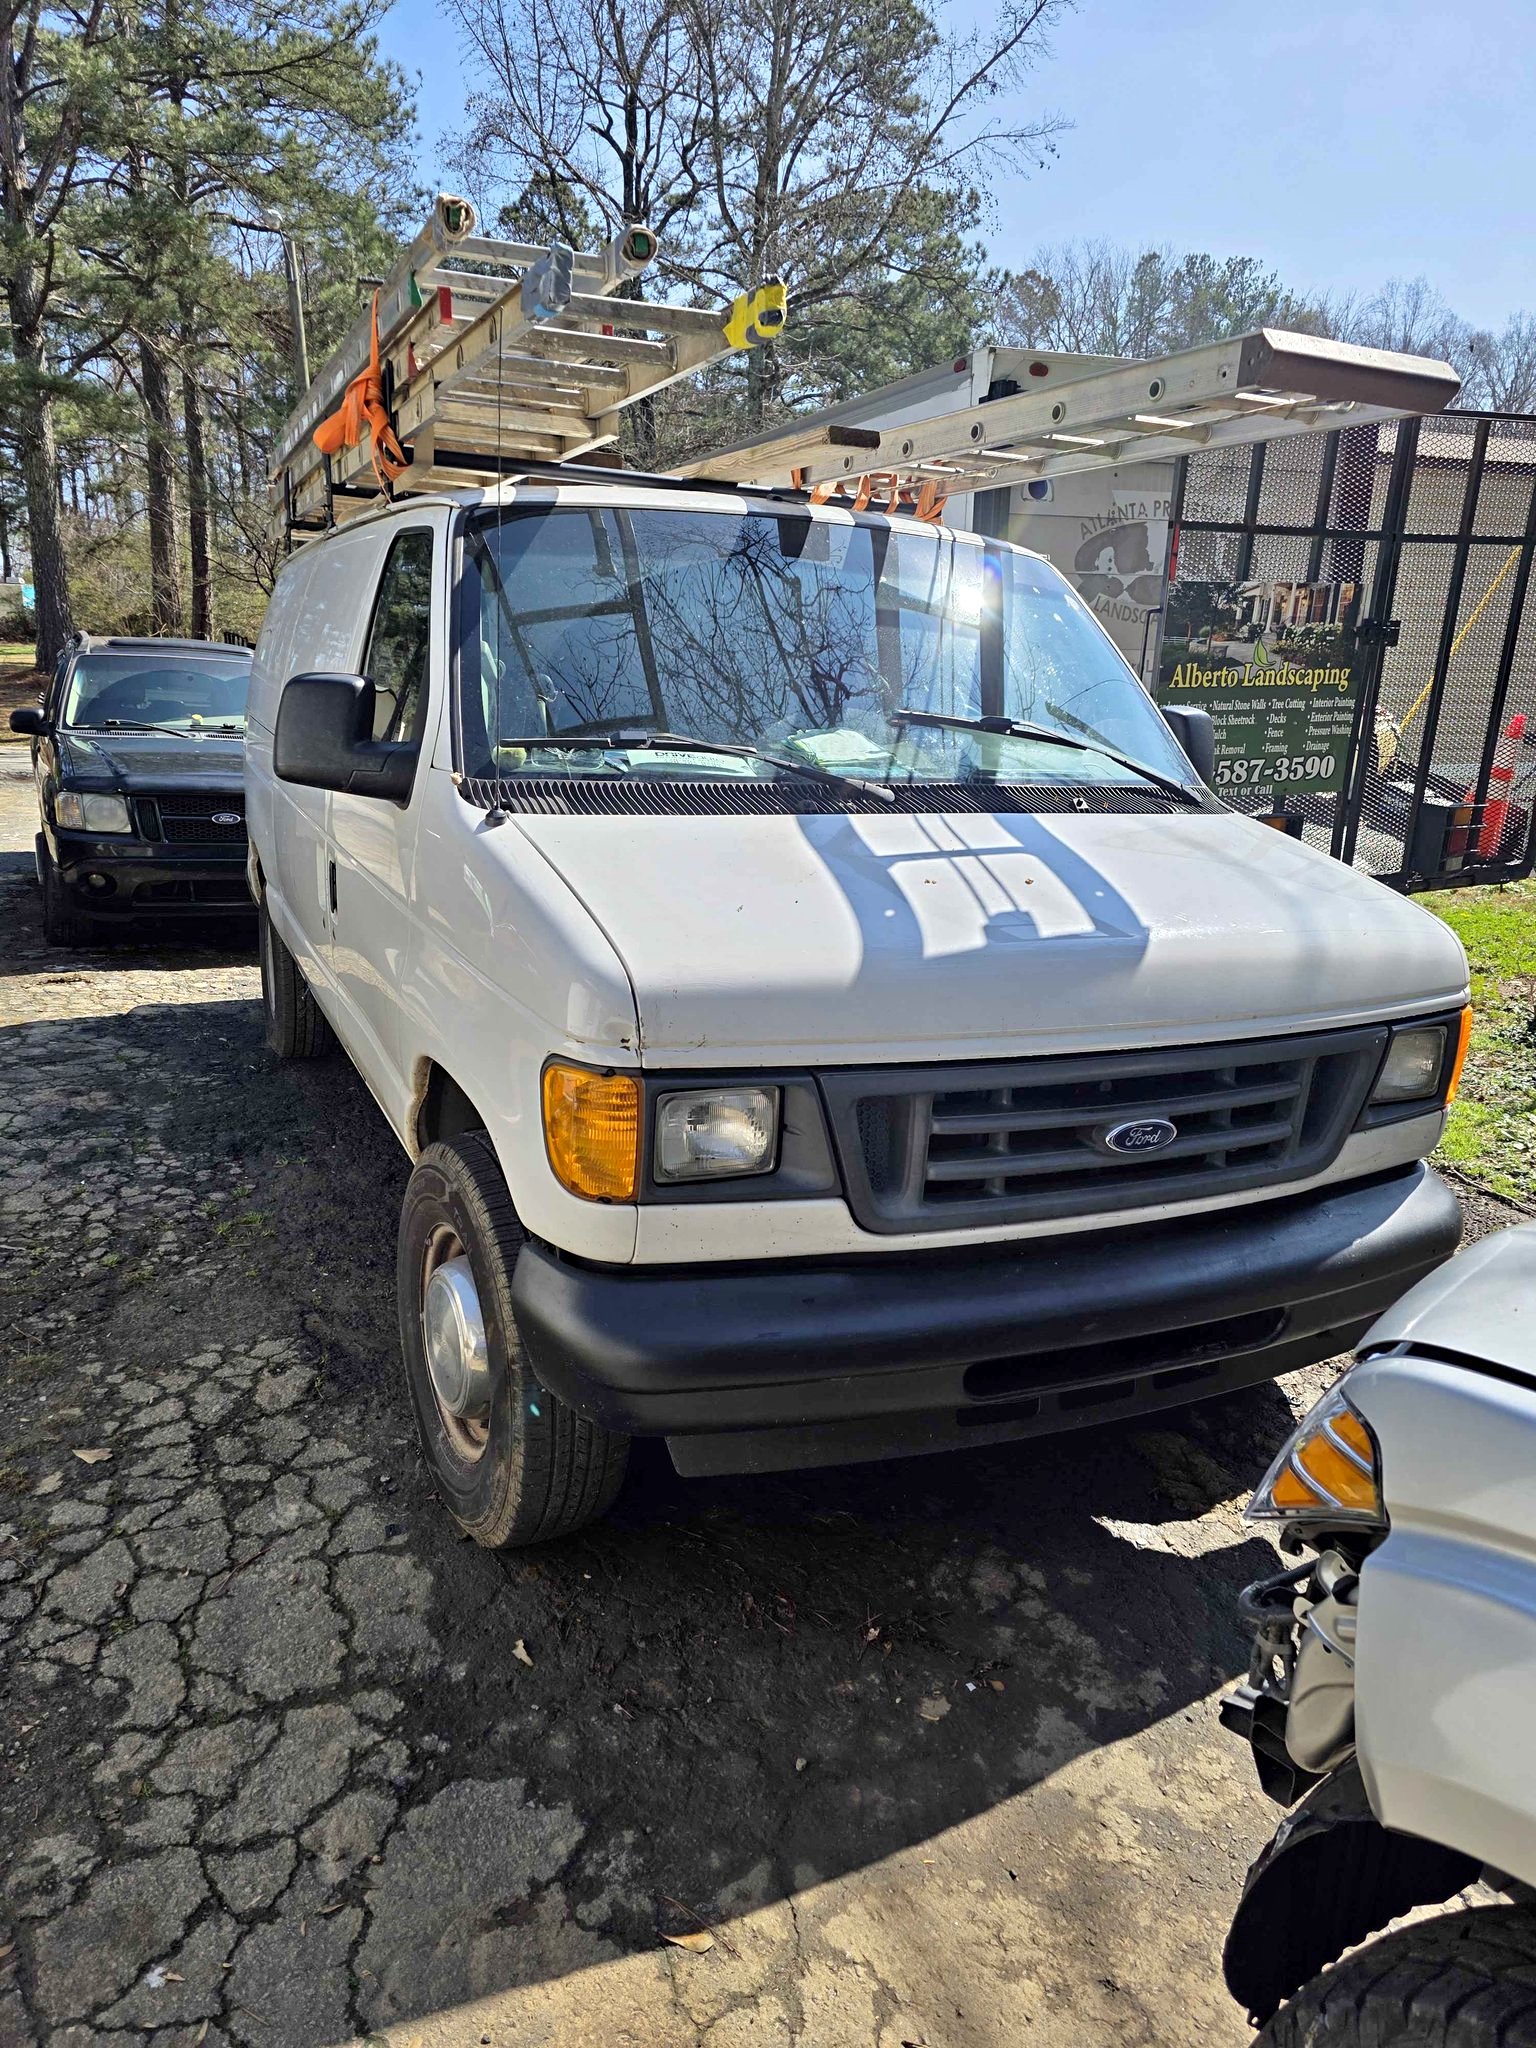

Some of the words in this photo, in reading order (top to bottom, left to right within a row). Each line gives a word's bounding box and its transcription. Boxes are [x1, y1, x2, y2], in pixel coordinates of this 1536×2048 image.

[1080, 502, 1148, 541] ATLANTA
[1168, 662, 1239, 688] Alberto
[1242, 661, 1351, 692] Landscaping
[1212, 699, 1234, 711] Natural
[1234, 699, 1250, 710] Stone
[1251, 698, 1267, 710] Walls
[1272, 698, 1284, 709] Tree
[1285, 697, 1306, 711] Cutting
[1312, 697, 1334, 708] Interior
[1334, 696, 1355, 709] Painting
[1227, 713, 1256, 726] Sheetrock
[1269, 712, 1287, 724] Decks
[1310, 711, 1333, 722] Exterior
[1333, 710, 1354, 723] Painting
[1267, 727, 1284, 738] Fence
[1308, 725, 1331, 736] Pressure
[1331, 724, 1352, 738] Washing
[1221, 743, 1246, 755] Removal
[1264, 742, 1288, 755] Framing
[1305, 740, 1330, 753] Drainage
[1213, 755, 1335, 785] 587-3590
[1217, 786, 1238, 797] Text
[1240, 786, 1252, 796] or
[1254, 784, 1273, 795] Call
[1125, 1126, 1162, 1147] Ford
